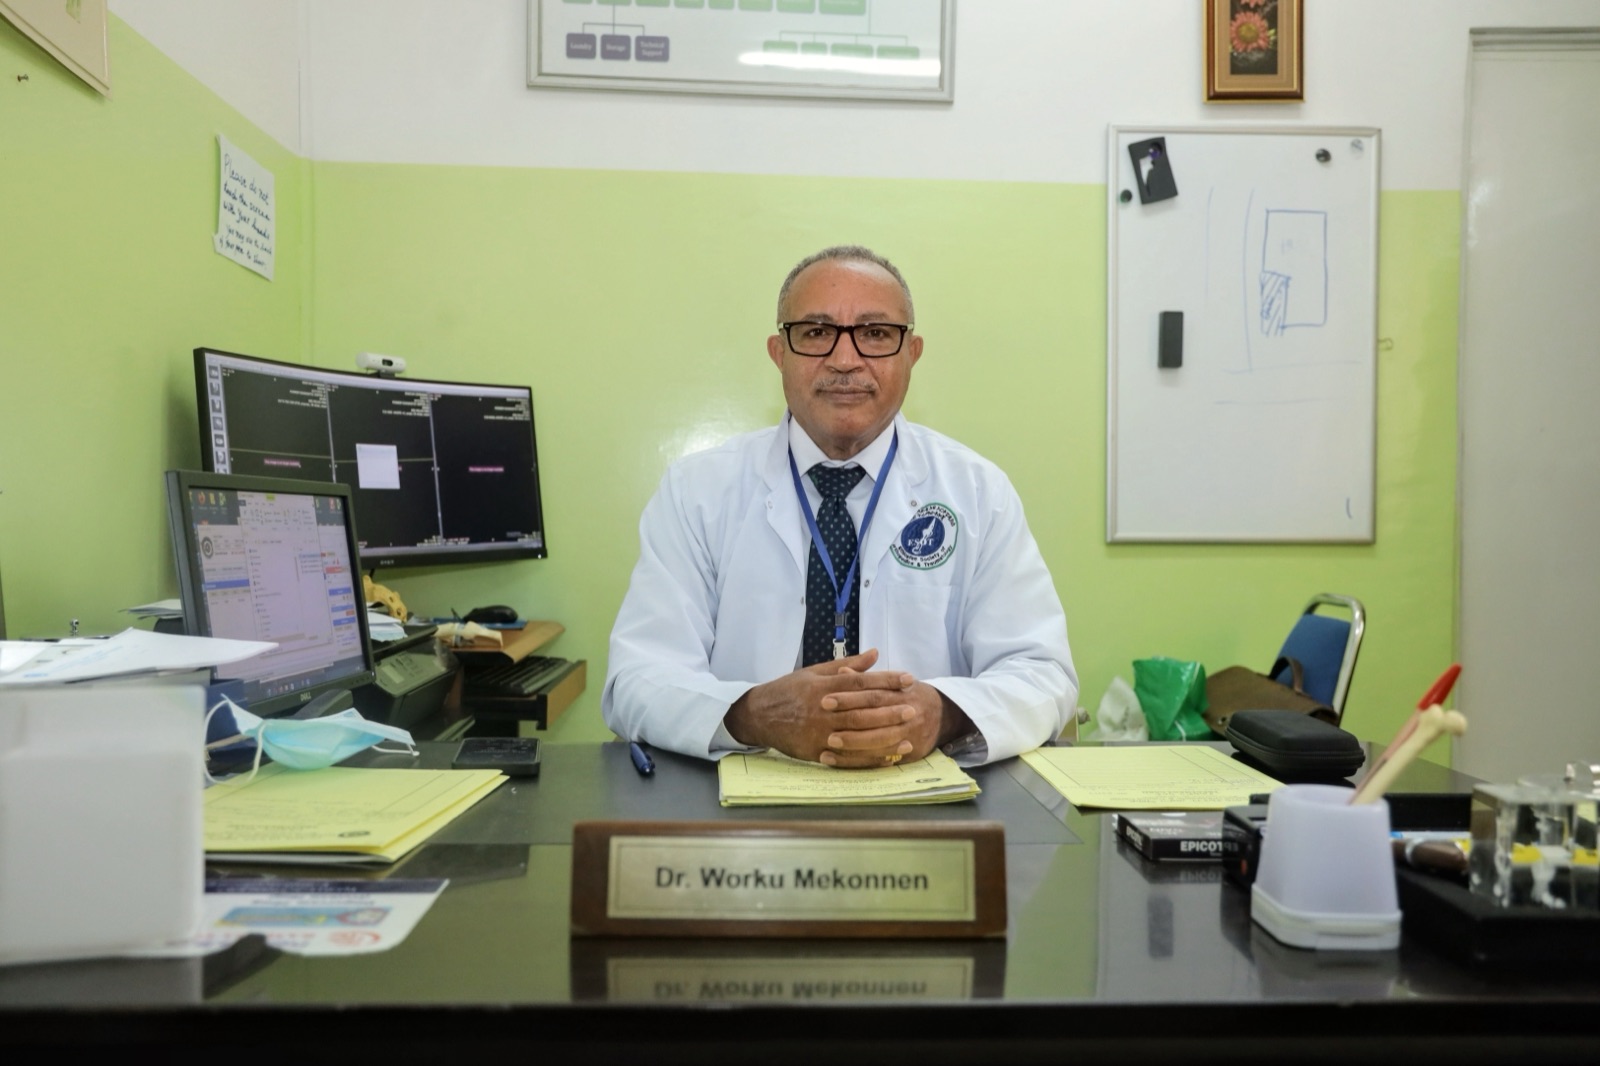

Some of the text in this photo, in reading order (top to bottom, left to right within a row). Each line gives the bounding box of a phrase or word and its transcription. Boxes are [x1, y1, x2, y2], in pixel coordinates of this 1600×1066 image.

[224, 153, 247, 189] Please
[920, 552, 940, 562] Society
[656, 867, 929, 890] Dr. Worku Mekonnen
